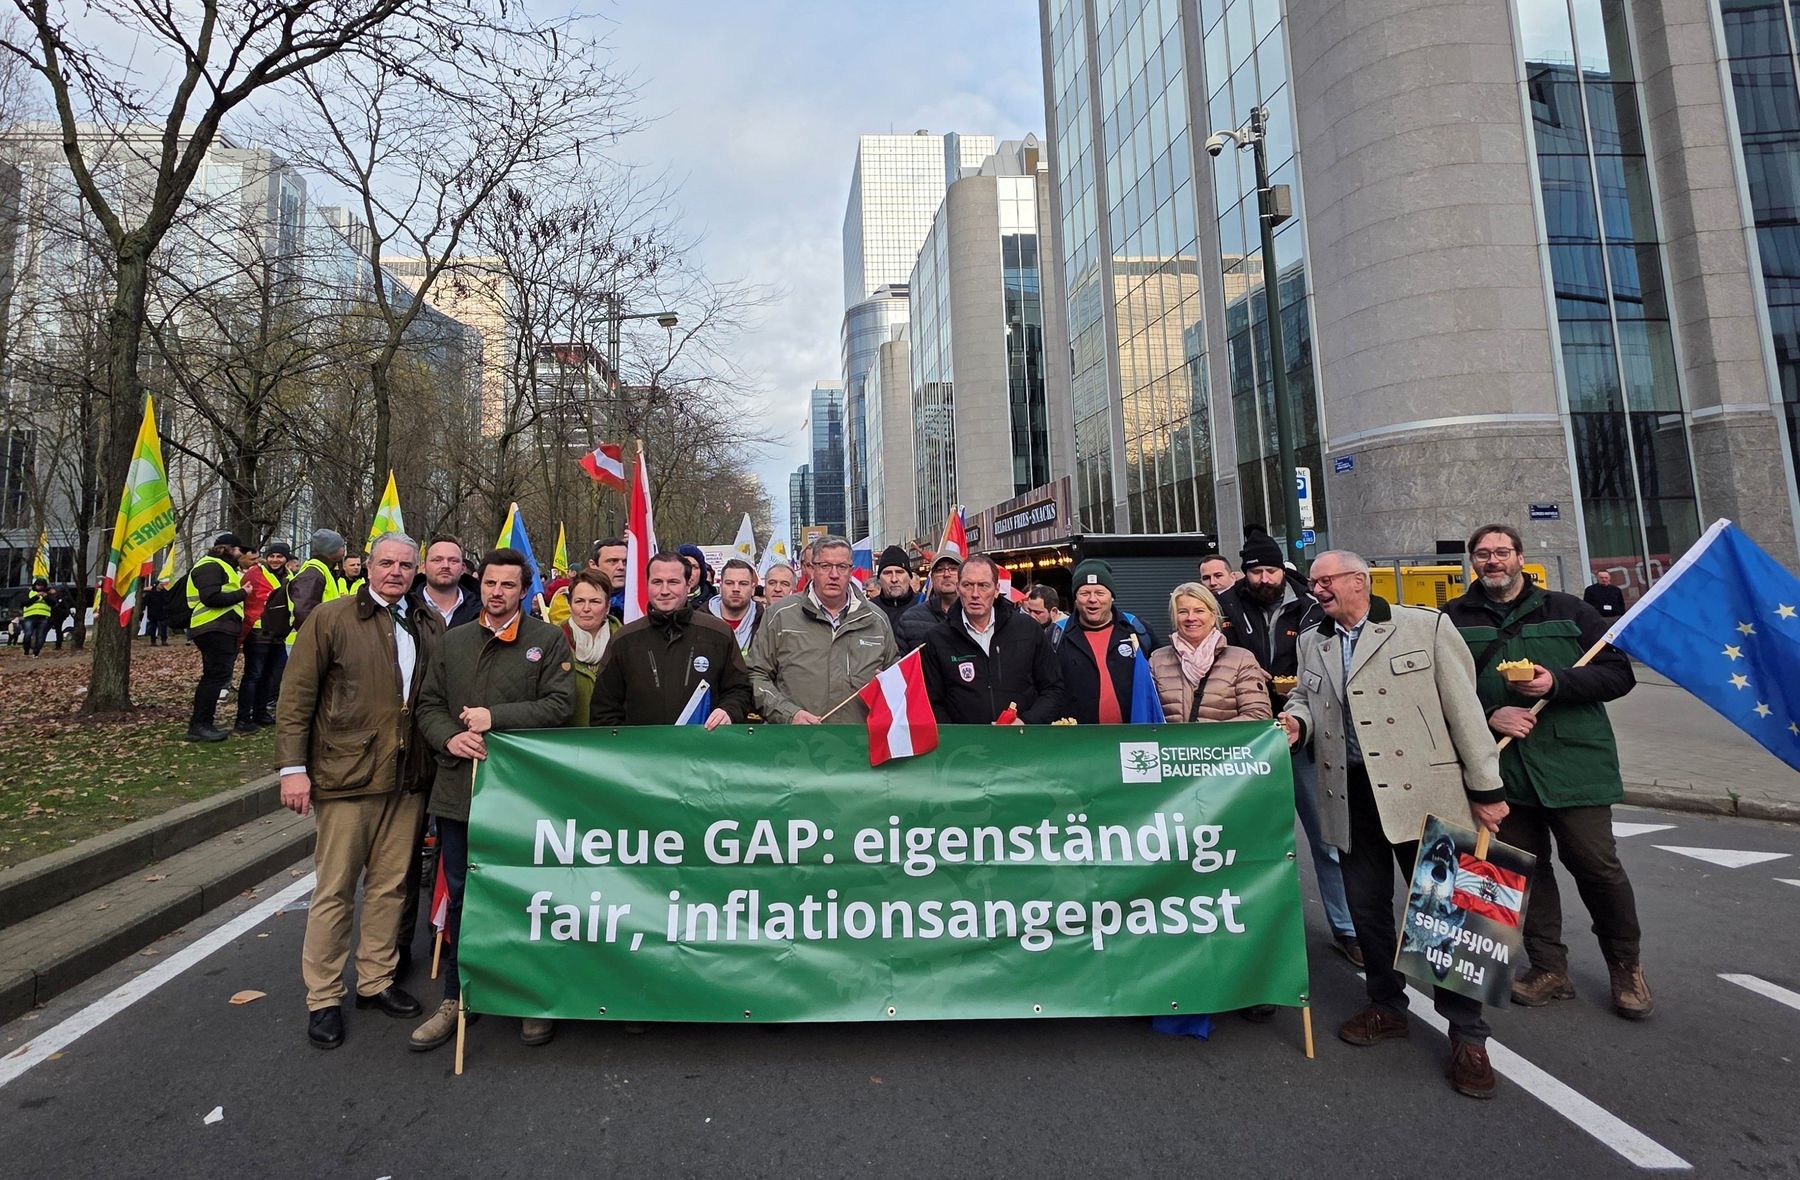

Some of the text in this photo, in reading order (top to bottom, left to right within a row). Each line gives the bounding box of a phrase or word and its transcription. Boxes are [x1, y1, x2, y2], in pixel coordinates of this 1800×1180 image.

[1161, 746, 1253, 762] STEIRISCHER
[1162, 761, 1271, 778] BAUERNBUND
[533, 812, 1237, 877] Neue GAP: eigenständig,
[526, 888, 1246, 952] fair, inflationsangepasst
[1414, 911, 1510, 965] Wolfsfreies
[1425, 945, 1486, 986] Für ein
